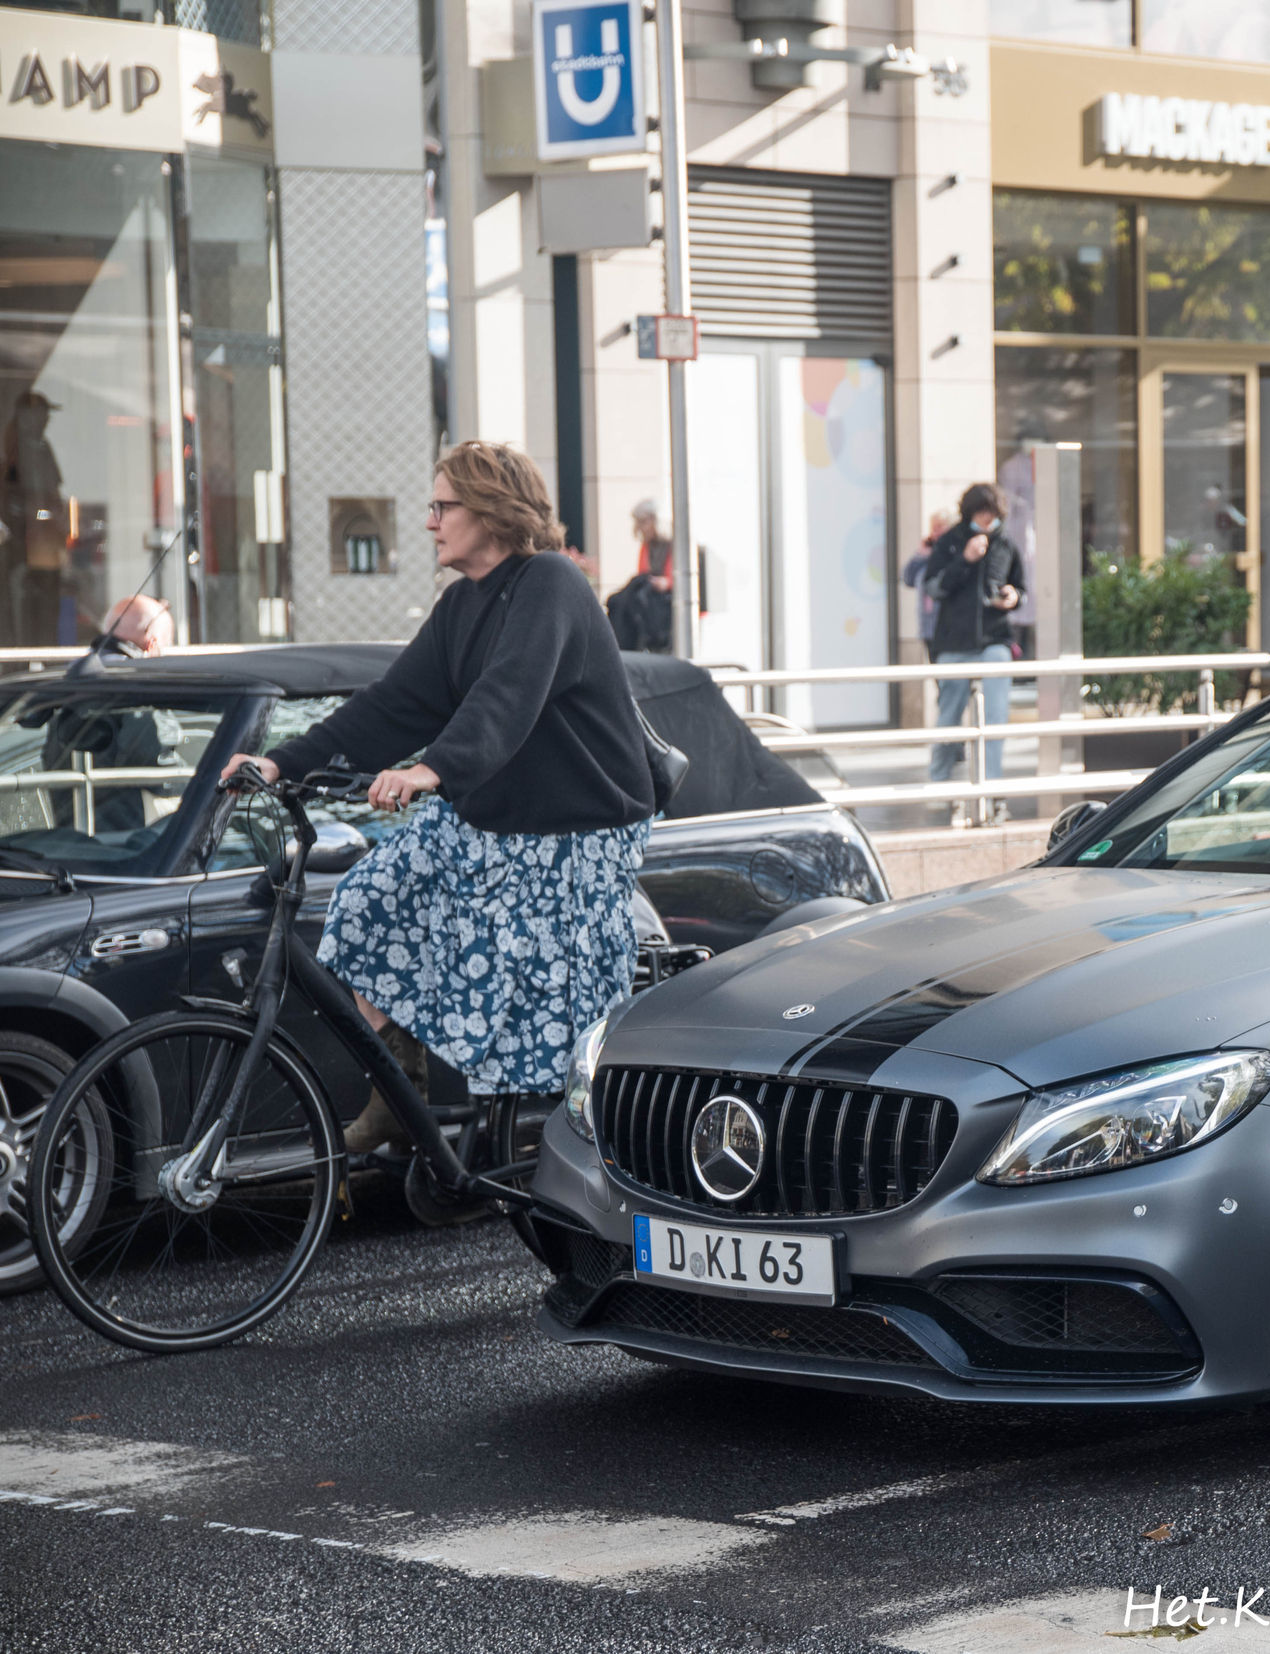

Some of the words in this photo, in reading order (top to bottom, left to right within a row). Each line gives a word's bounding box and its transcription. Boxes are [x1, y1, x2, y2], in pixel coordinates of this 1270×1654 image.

[0, 48, 161, 113] AMP
[555, 18, 620, 126] U
[641, 1249, 648, 1263] D
[666, 1227, 686, 1272] D
[705, 1234, 747, 1281] KI
[759, 1240, 804, 1285] 63
